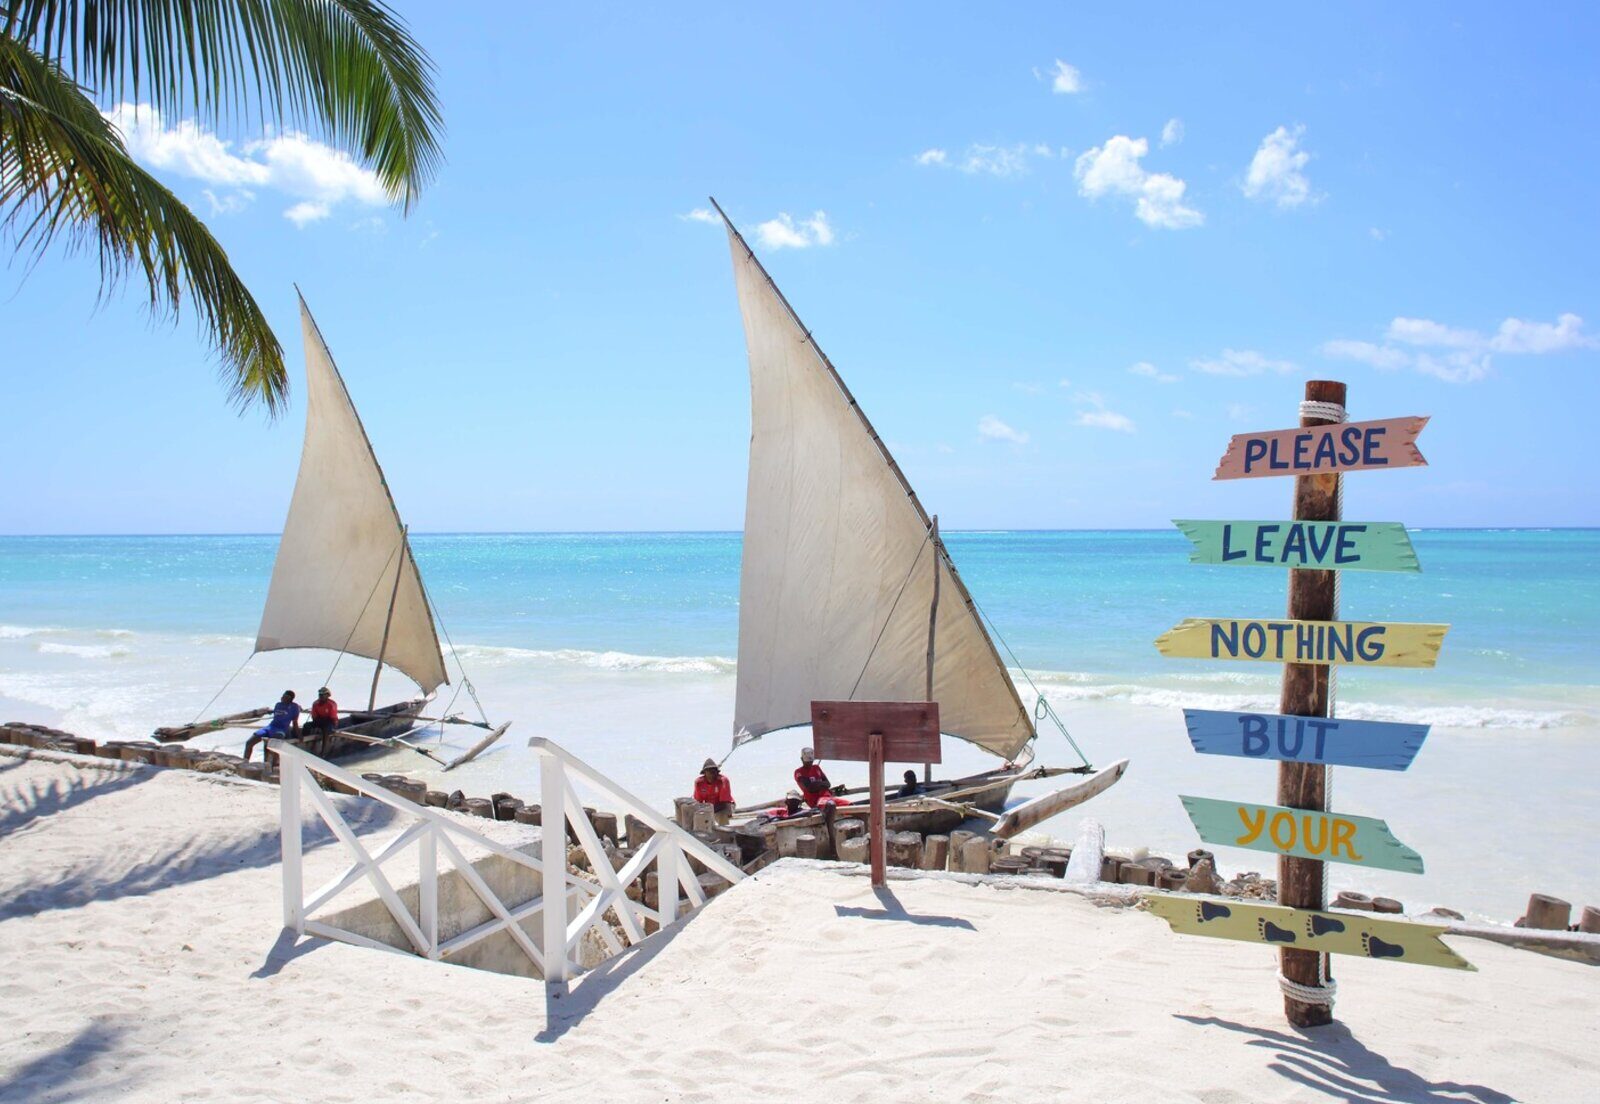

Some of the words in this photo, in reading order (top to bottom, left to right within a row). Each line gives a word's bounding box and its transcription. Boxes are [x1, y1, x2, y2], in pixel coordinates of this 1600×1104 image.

[1244, 427, 1388, 473] PLEASE
[1221, 523, 1367, 564] LEAVE
[1211, 621, 1386, 662] NOTHING
[1237, 714, 1339, 760] BUT
[1235, 806, 1363, 861] YOUR
